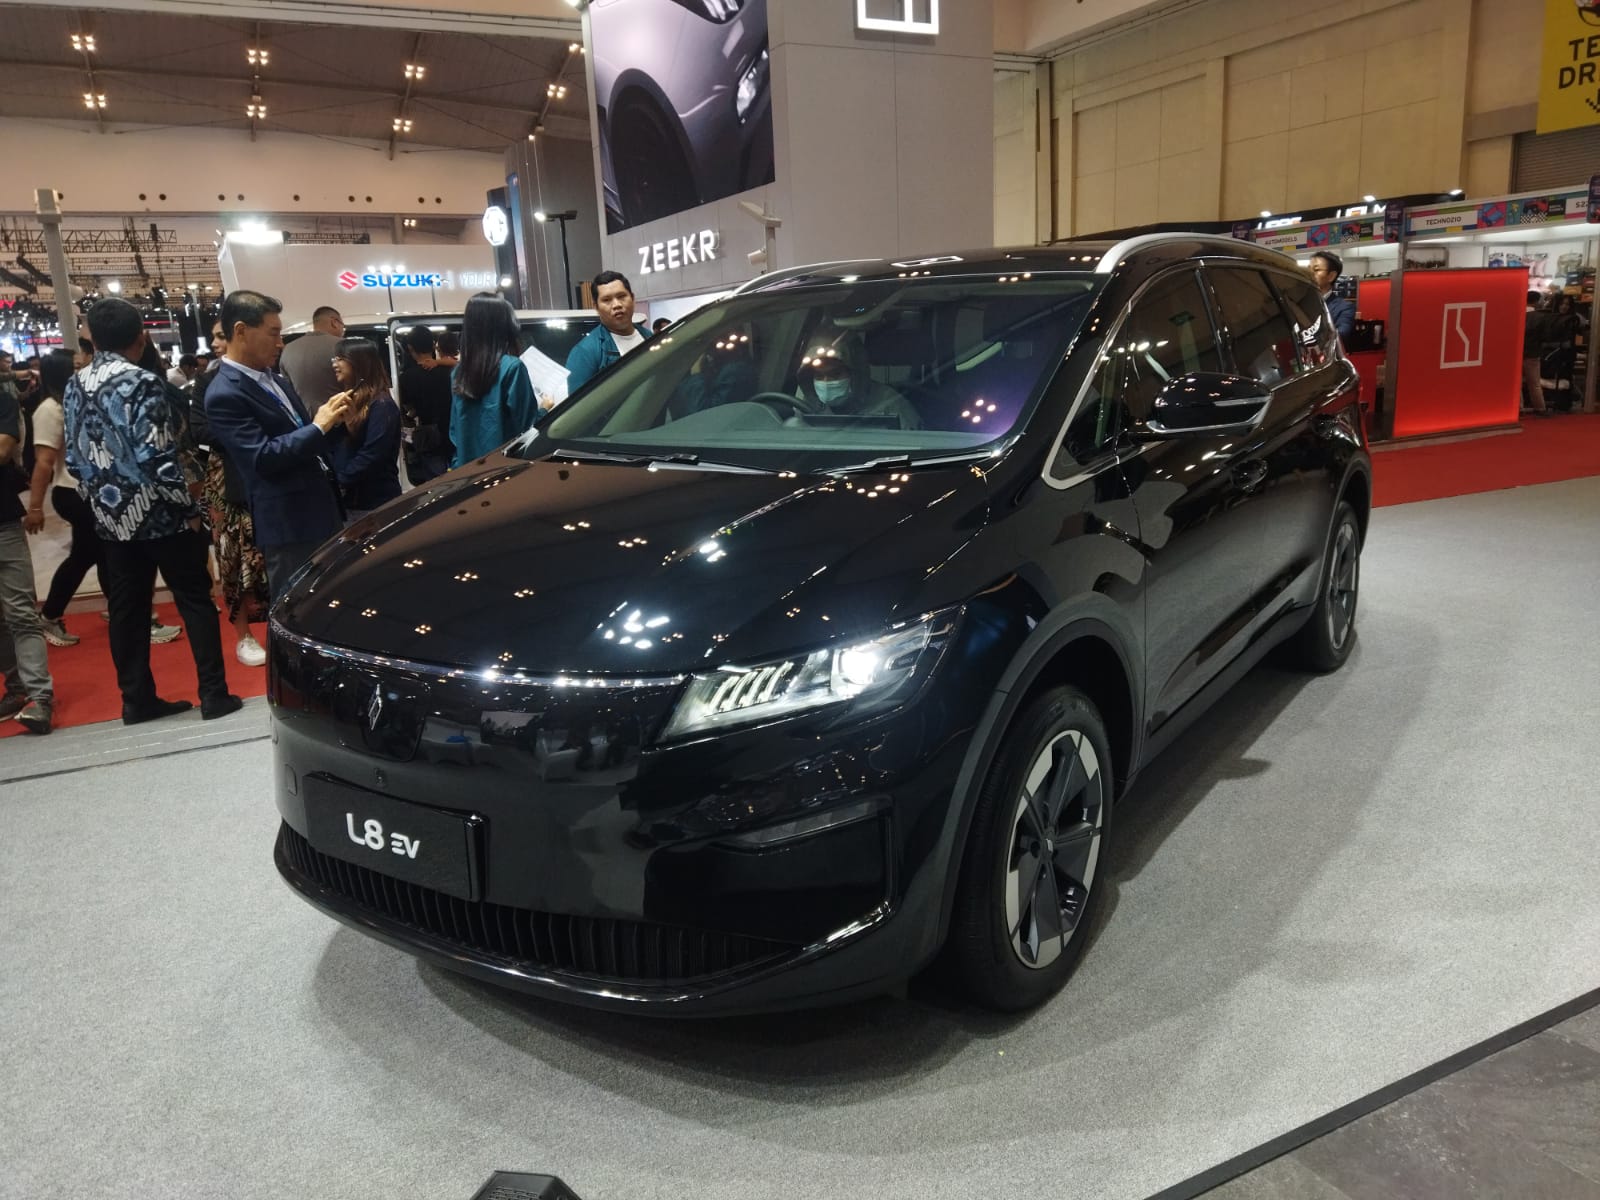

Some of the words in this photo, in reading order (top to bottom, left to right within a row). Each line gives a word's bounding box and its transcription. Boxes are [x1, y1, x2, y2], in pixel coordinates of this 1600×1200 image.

[1558, 62, 1600, 90] DR
[1426, 215, 1462, 226] TECHNOZIO
[638, 229, 716, 275] ZEEKR
[362, 273, 441, 287] SUZUKI
[346, 812, 385, 850] L8
[390, 832, 420, 859] EV
